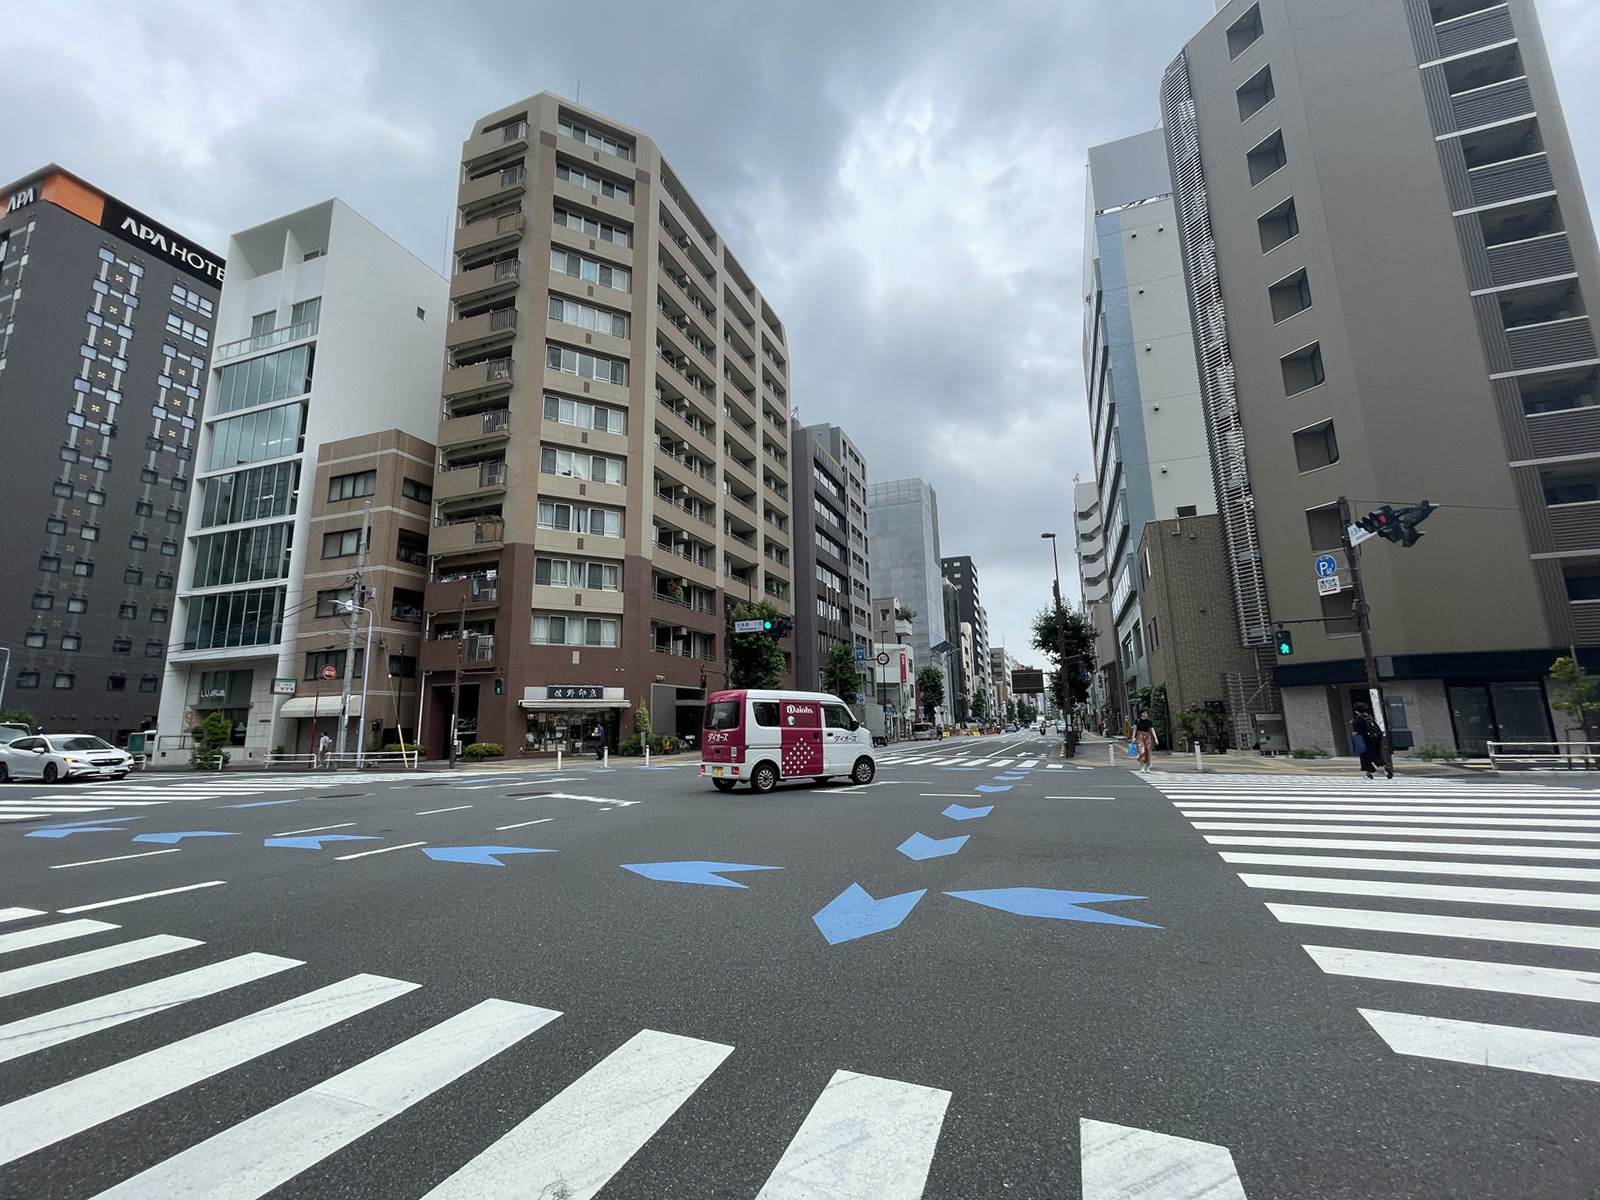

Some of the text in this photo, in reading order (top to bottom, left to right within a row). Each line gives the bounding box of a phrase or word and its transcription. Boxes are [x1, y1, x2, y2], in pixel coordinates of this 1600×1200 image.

[7, 187, 34, 214] APA
[120, 216, 168, 253] APA
[1319, 561, 1328, 576] P
[786, 704, 814, 714] Daiohs
